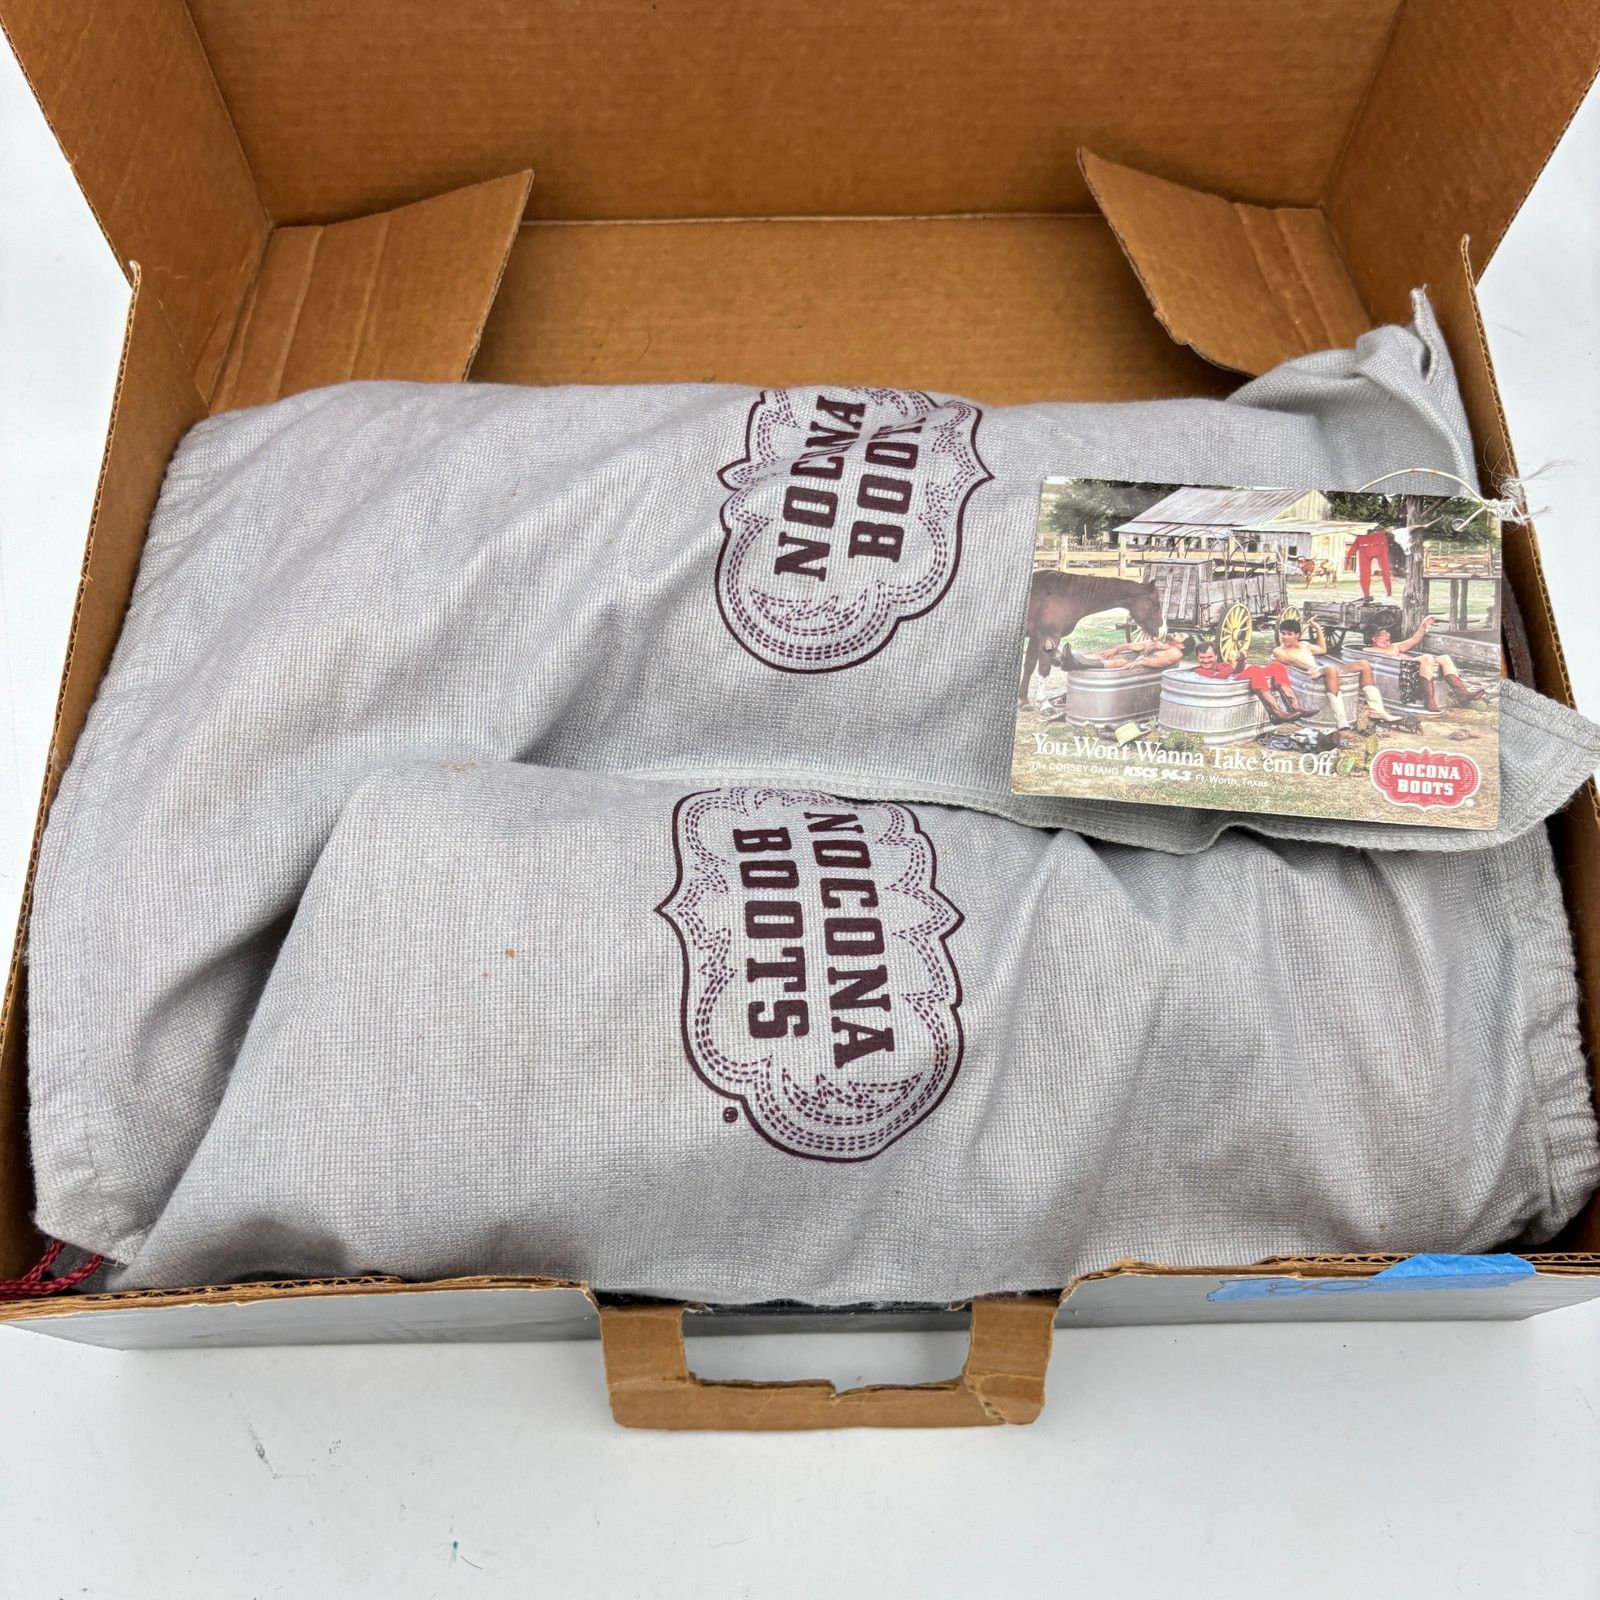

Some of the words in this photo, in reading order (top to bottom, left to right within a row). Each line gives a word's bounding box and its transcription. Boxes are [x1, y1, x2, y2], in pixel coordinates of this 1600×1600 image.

[1032, 733, 1070, 756] You
[1135, 741, 1204, 766] Wanna
[1209, 746, 1258, 770] Take
[1299, 749, 1338, 777] Off.
[1391, 762, 1461, 780] NOCONA
[1049, 762, 1089, 773] DORSEY
[1091, 766, 1119, 775] GANG
[1161, 769, 1192, 782] 96.3
[1194, 774, 1207, 785] Ft.
[1242, 778, 1270, 788] Texas
[1396, 779, 1454, 796] BOOTS
[732, 826, 810, 1039] BOOTS
[803, 811, 896, 1069] NOCONA
